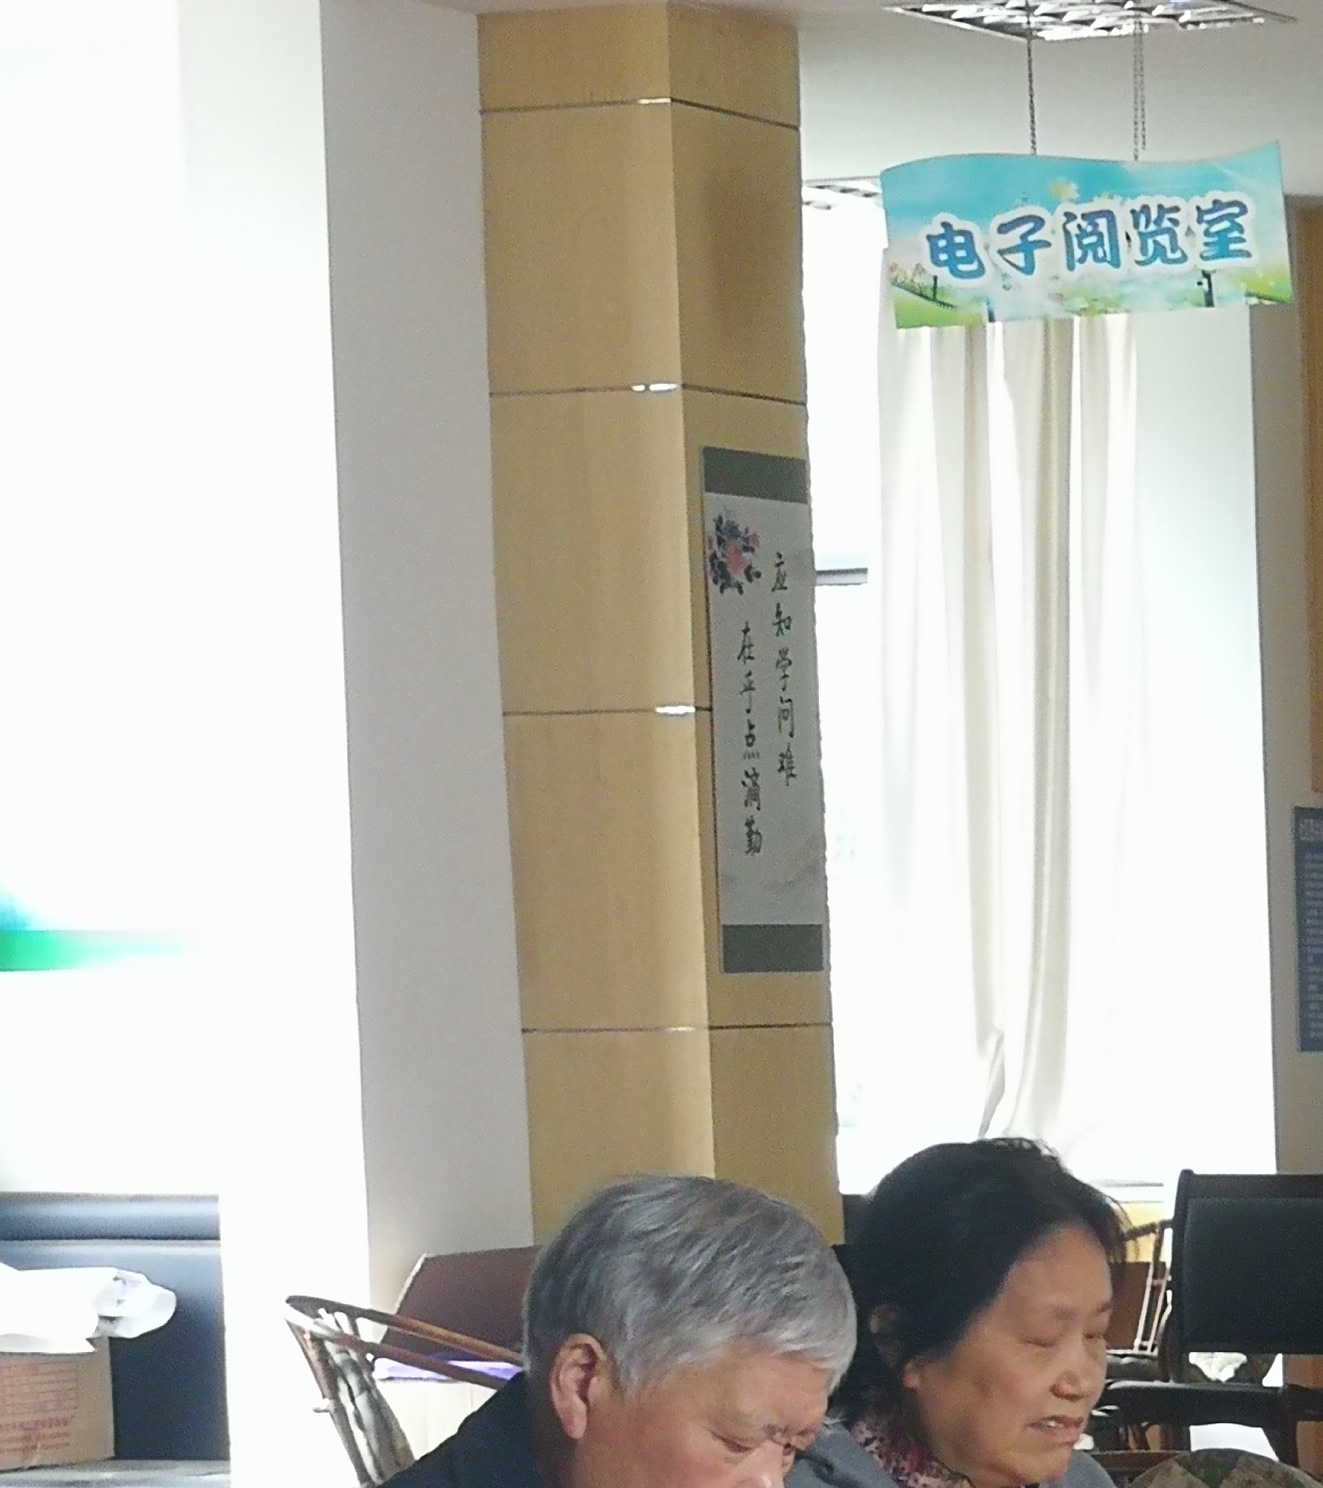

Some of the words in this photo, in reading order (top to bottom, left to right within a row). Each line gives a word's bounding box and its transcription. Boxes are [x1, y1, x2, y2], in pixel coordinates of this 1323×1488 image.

[926, 199, 1252, 280] 电子阅览室
